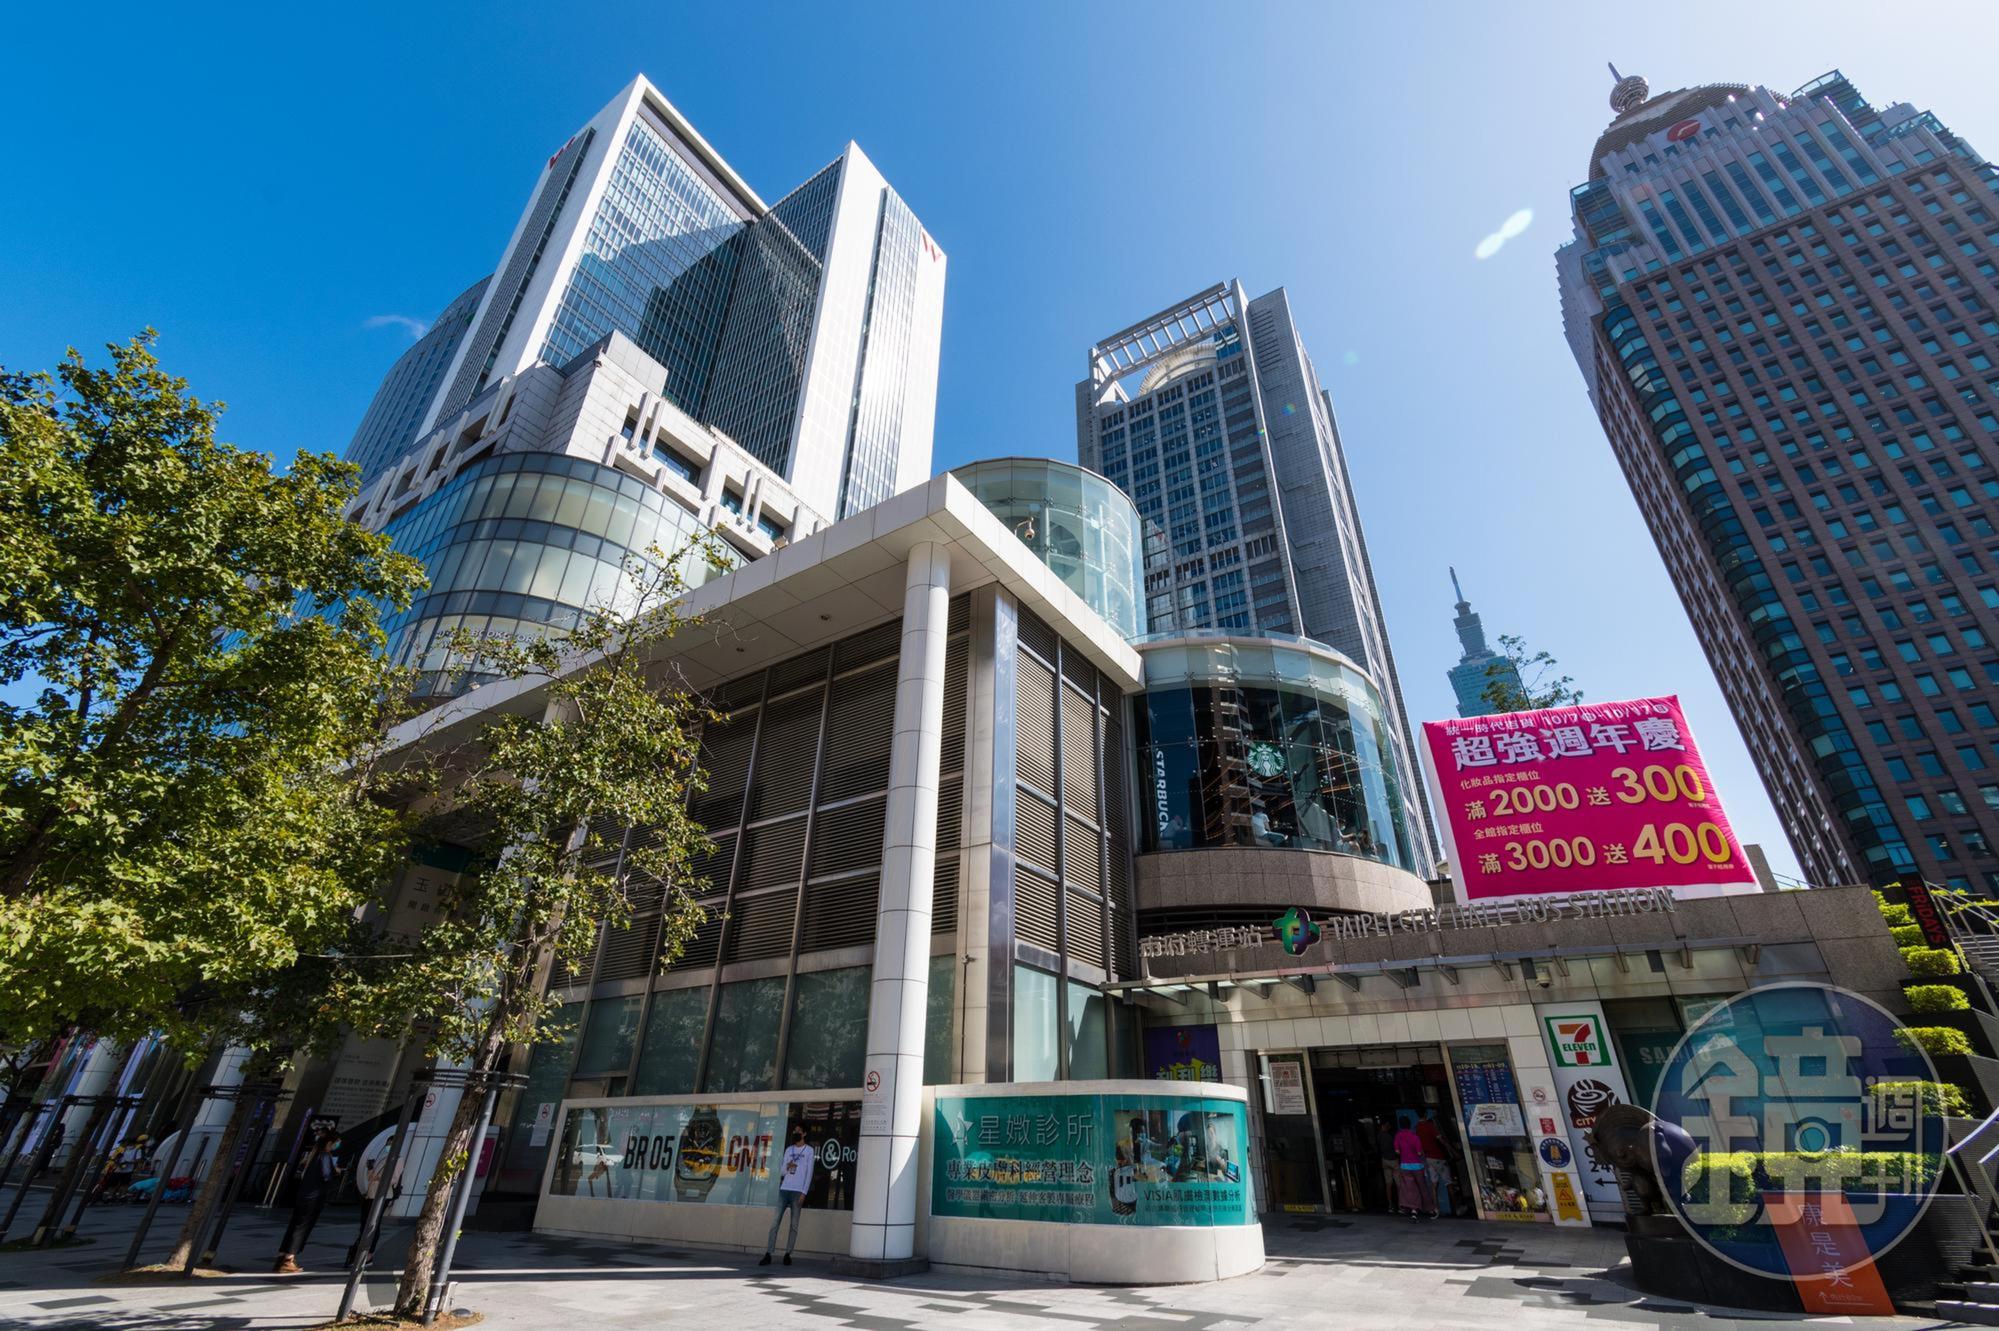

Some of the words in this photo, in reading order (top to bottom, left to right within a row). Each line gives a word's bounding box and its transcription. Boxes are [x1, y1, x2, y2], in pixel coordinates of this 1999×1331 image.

[1451, 717, 1687, 772] 超強週年慶
[1460, 769, 1541, 790] 化妝品指定櫃位
[1465, 800, 1487, 821] 滿
[1489, 783, 1580, 817] 2000
[1586, 785, 1612, 807] 送
[1611, 764, 1706, 804] 300
[1472, 821, 1544, 841] 全館指定櫃位
[1478, 853, 1502, 875] 滿
[1504, 836, 1596, 871] 3000
[1602, 843, 1629, 865] 送
[1632, 822, 1732, 865] 400
[1328, 911, 1394, 941] TAIPEI
[1397, 907, 1442, 934] CITY
[1451, 901, 1512, 930] HALL
[1514, 895, 1562, 924] BUS
[1567, 886, 1676, 921] STATION
[1138, 923, 1263, 958] 市府轉運站
[726, 1134, 774, 1174] GMT
[841, 1145, 860, 1163] Ro
[1798, 1203, 1854, 1288] 康是美
